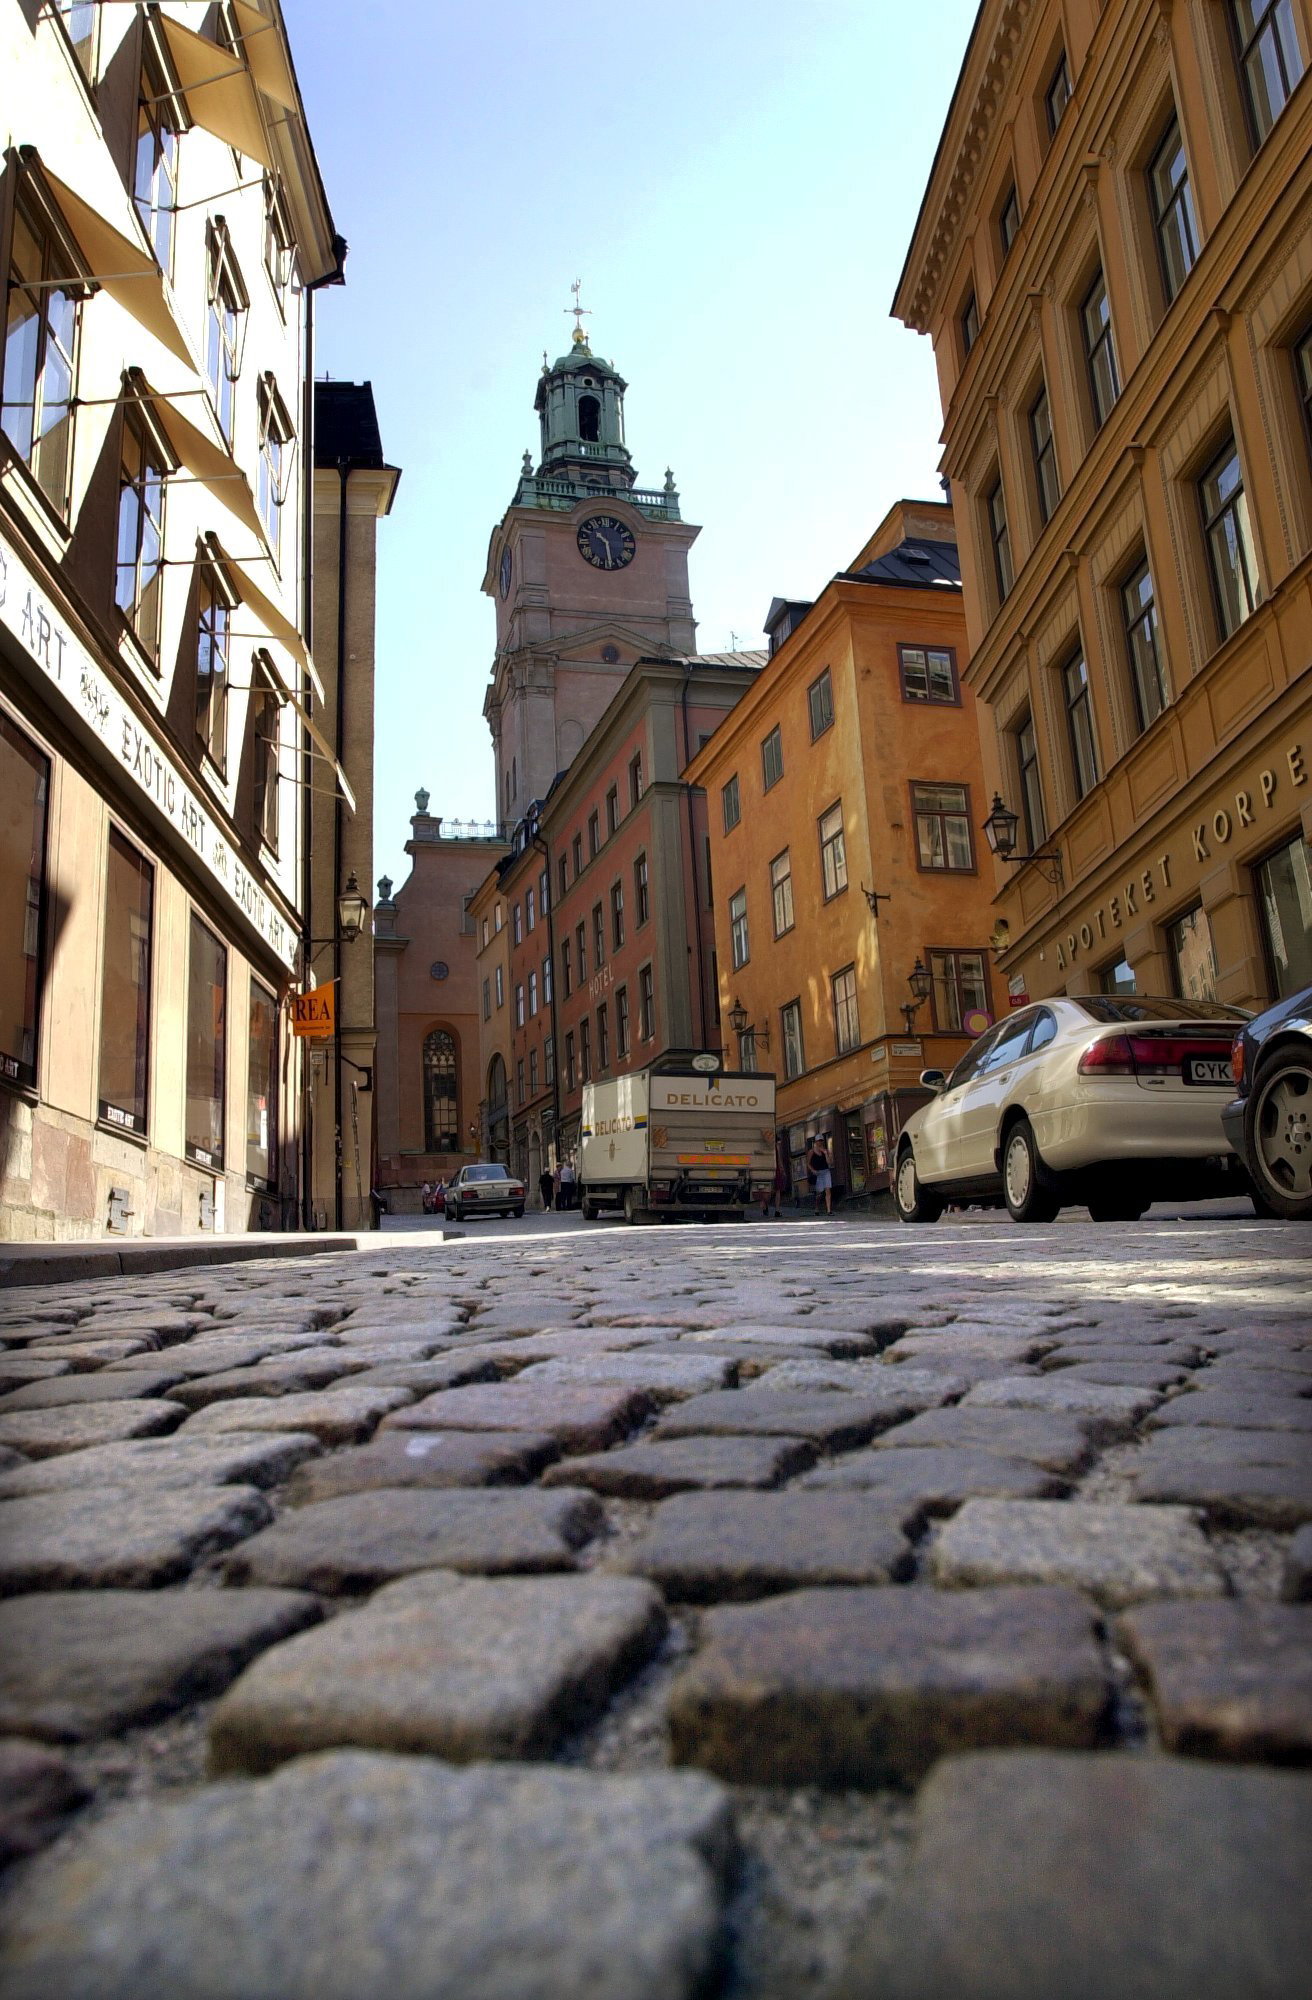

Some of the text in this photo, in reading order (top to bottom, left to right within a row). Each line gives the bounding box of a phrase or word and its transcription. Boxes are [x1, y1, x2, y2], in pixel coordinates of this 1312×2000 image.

[21, 588, 68, 681] ART
[121, 713, 206, 852] EXOTIC ART
[234, 862, 285, 955] EXOTIC ART
[1055, 854, 1172, 971] APOTEKET
[588, 962, 615, 1001] HOTEL
[295, 998, 331, 1022] REA
[1194, 1062, 1231, 1079] CYK
[666, 1092, 759, 1107] DELICATO
[594, 1116, 632, 1137] DELICATO
